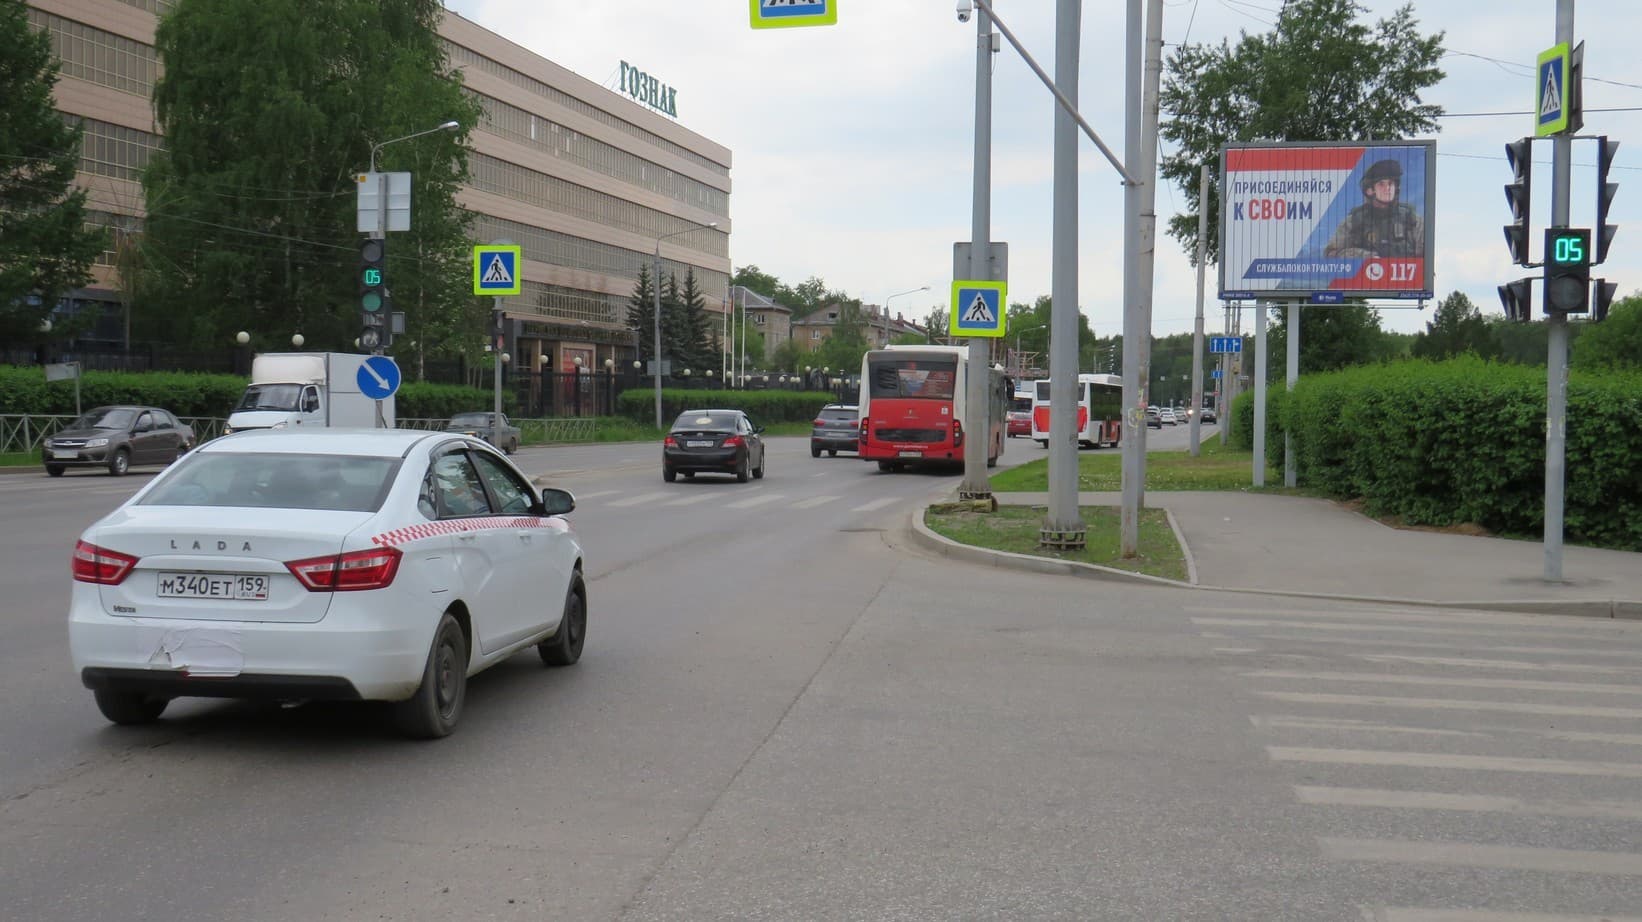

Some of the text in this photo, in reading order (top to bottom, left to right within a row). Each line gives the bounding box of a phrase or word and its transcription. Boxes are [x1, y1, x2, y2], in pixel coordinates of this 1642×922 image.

[620, 59, 678, 118] ГОЗНАК
[1234, 178, 1332, 195] ПРИСОЕДИНЯЙСЯ
[1234, 198, 1313, 220] К СВОИМ
[1556, 239, 1582, 261] 05
[366, 270, 380, 284] 05
[1256, 263, 1352, 273] СЛУЖБАПОКОНТРАКТУ.РФ
[1390, 263, 1417, 281] 117
[170, 539, 252, 552] LADA
[161, 575, 264, 596] М340ЕТ 159
